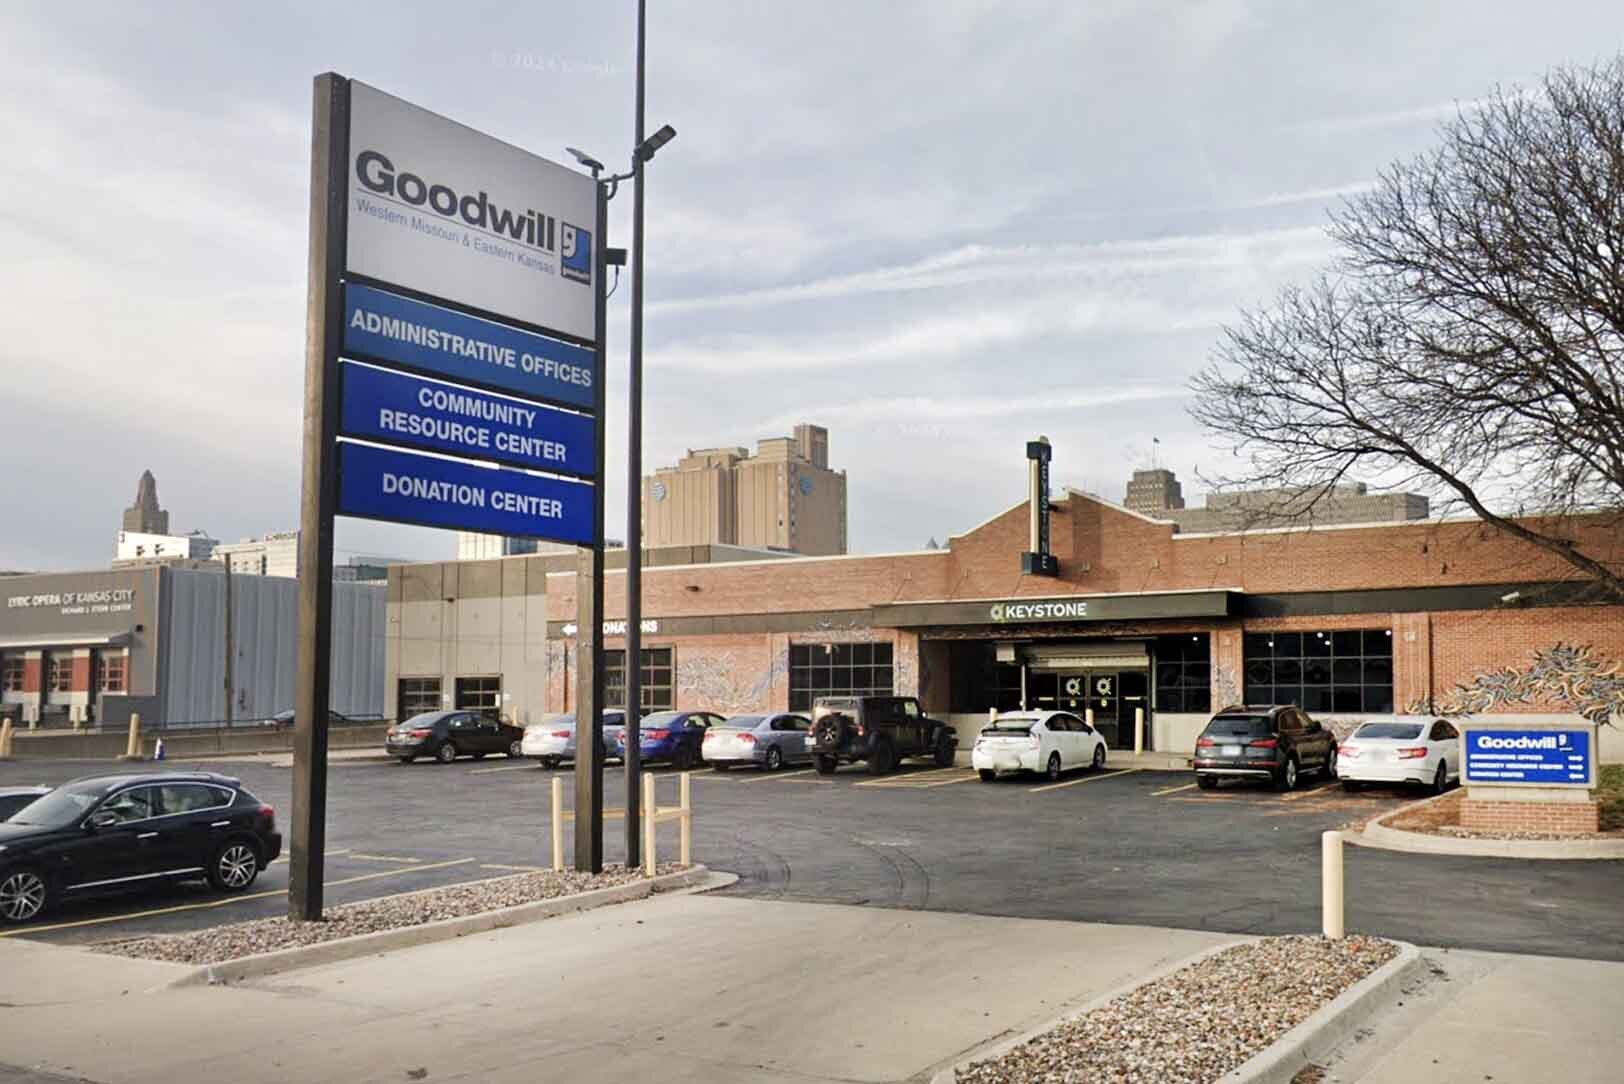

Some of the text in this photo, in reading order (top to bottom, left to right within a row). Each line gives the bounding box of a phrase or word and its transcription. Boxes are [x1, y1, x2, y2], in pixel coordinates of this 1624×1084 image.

[356, 150, 555, 252] Goodwill
[518, 253, 555, 276] Kansas
[351, 308, 592, 387] ADMINISTRATIVE OFFICES
[419, 387, 536, 429] COMMUNITY
[380, 408, 566, 462] RESOURCE CENTER
[383, 472, 562, 518] DONATION CENTER
[33, 593, 61, 606] OPERA
[62, 592, 76, 604] OF
[77, 590, 112, 603] KANSAS
[113, 589, 134, 601] CITY
[1006, 602, 1088, 619] KEYSTONE
[1477, 735, 1557, 749] Goodwill
